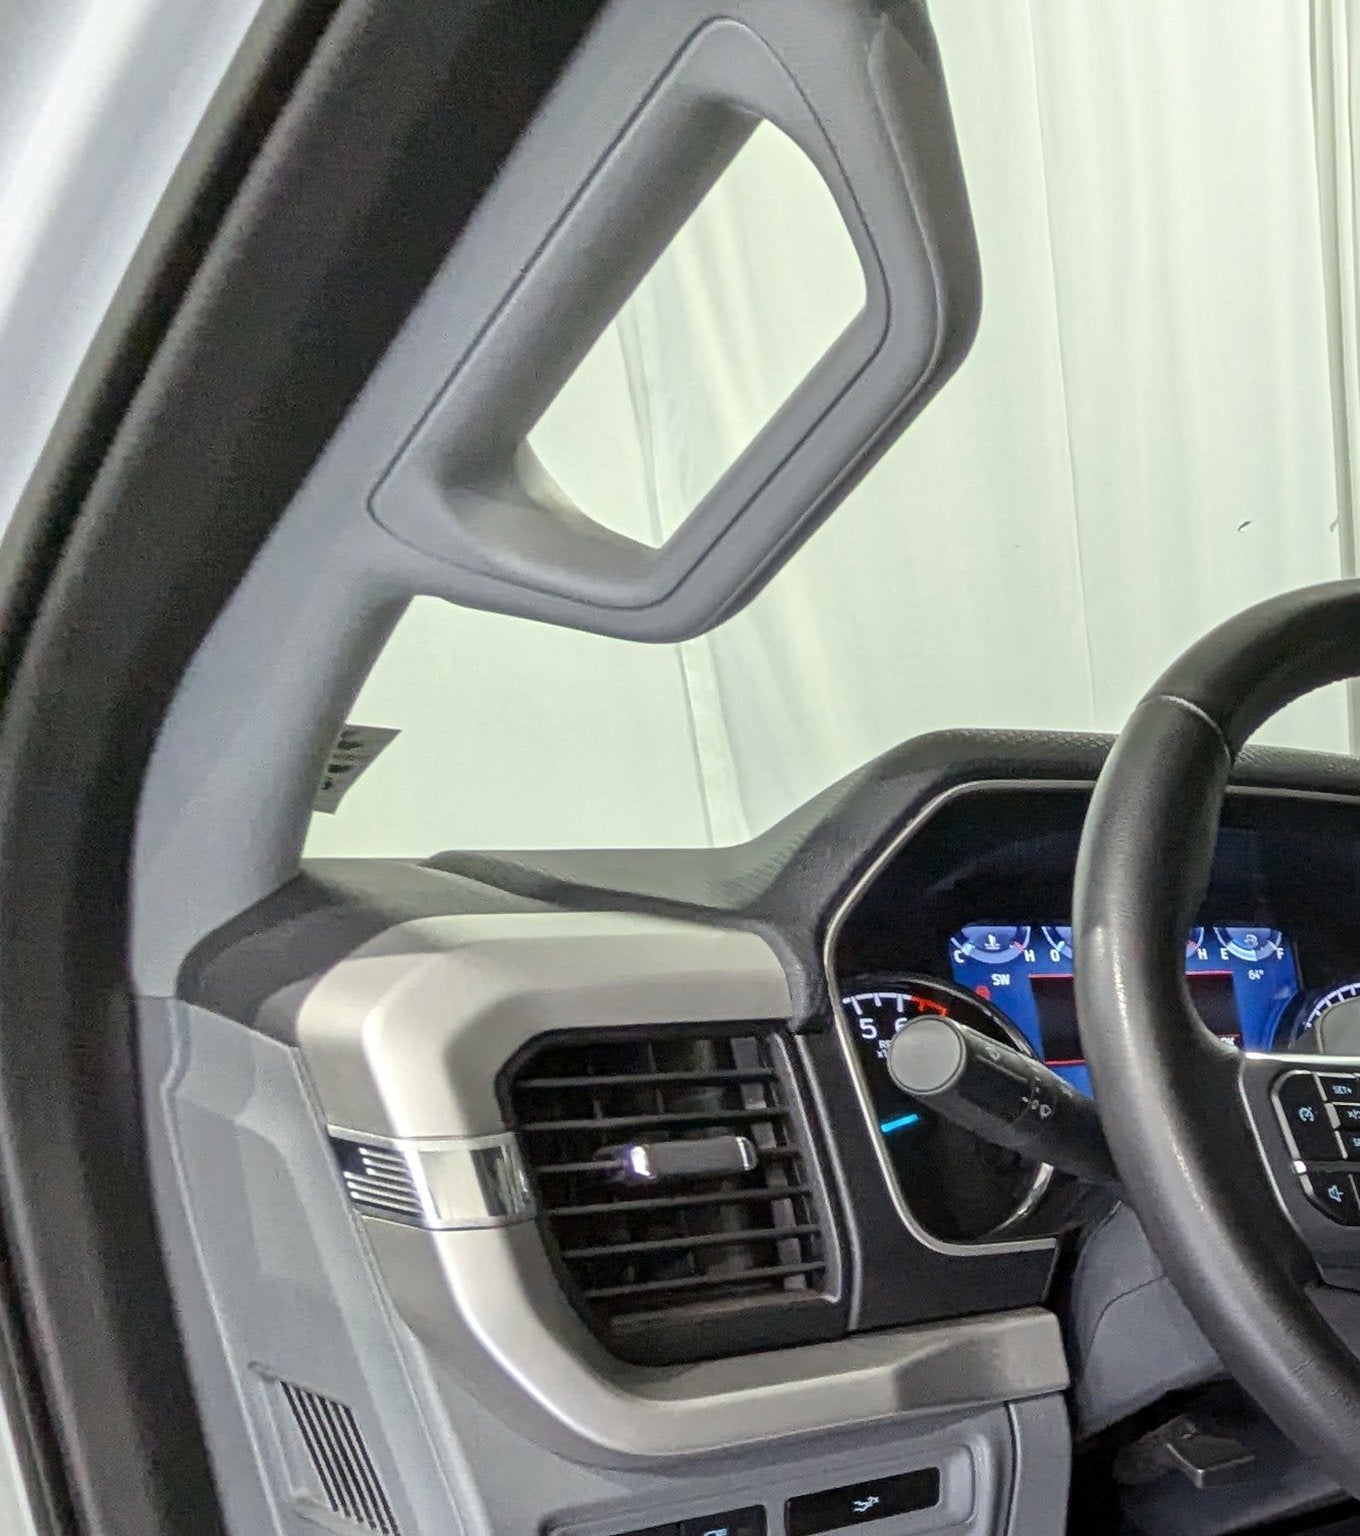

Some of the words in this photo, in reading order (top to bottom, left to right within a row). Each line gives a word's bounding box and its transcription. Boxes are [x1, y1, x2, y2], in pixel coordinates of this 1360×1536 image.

[1024, 949, 1036, 963] H
[1197, 948, 1208, 960] H
[1220, 947, 1230, 960] E
[1276, 947, 1285, 960] F
[859, 1017, 878, 1039] 5
